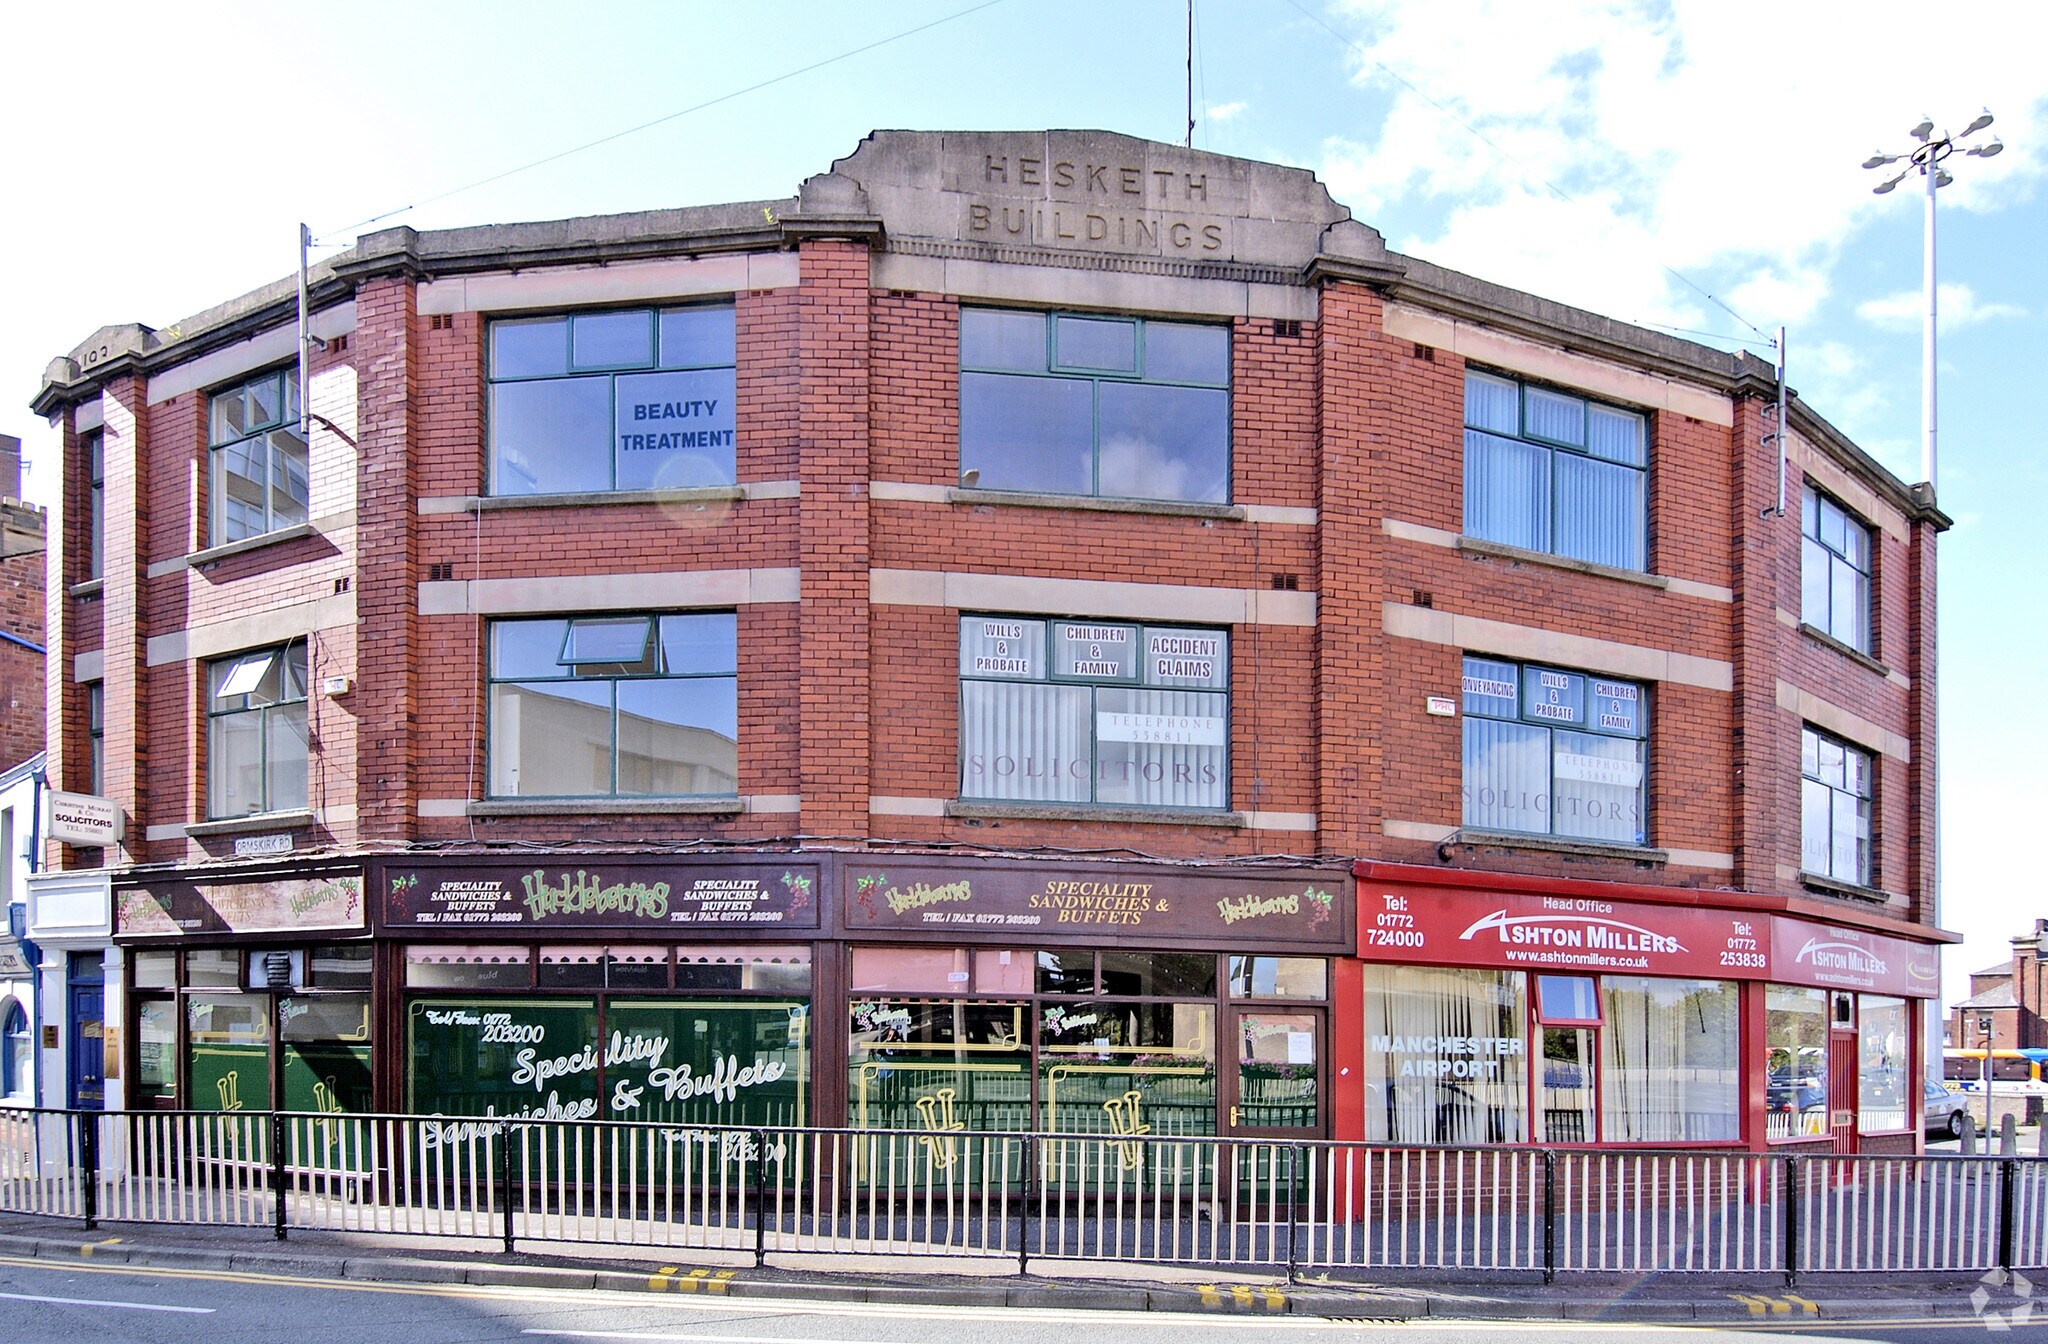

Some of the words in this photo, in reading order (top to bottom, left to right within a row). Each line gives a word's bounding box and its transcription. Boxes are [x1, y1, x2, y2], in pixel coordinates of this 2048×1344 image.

[985, 154, 1207, 201] HESKETH
[969, 203, 1222, 251] BUILDINGS
[634, 400, 718, 420] BEAUTY
[621, 430, 734, 451] TREATMENT
[985, 624, 1021, 638] WILLS
[1067, 627, 1125, 641] CHILDREN
[999, 642, 1006, 654] &
[1091, 645, 1101, 658] &
[1152, 638, 1217, 656] ACCIDENT
[976, 659, 1027, 672] PROBATE
[1075, 662, 1118, 675] FAMILY
[1158, 661, 1211, 677] CLAIMS
[1542, 674, 1567, 688] WILLS
[1596, 684, 1636, 699] CHILDREN
[1536, 704, 1572, 720] PROBATE
[1112, 715, 1214, 730] TELEPHONE
[1601, 715, 1631, 729] FAMILY
[1132, 730, 1193, 743] 558811
[968, 755, 1217, 784] SOLICITORS
[1565, 755, 1637, 772] TELEPHONE
[1462, 785, 1638, 823] SOLICITORS
[55, 814, 112, 828] SOLICITORS
[236, 839, 277, 852] ORMSKIRK
[440, 882, 502, 891] SPECIALITY
[693, 880, 760, 890] SPECIALITY
[1045, 880, 1153, 897] SPECIALITY
[430, 891, 501, 901] SANDWICHES
[502, 891, 512, 901] &
[521, 869, 670, 921] Huckleberries
[683, 890, 758, 900] SANDWICHES
[759, 890, 770, 900] &
[1028, 894, 1151, 912] SANDWICHES
[1155, 898, 1169, 912] &
[1383, 895, 1408, 911] Tel:
[447, 901, 496, 911] BUFFETS
[701, 901, 753, 911] BUFFETS
[1544, 897, 1572, 910] Head
[1577, 900, 1613, 913] Office
[1057, 909, 1142, 925] BUFFETS
[1377, 913, 1414, 928] 01772
[1733, 922, 1752, 936] Tel:
[1367, 929, 1424, 948] 724000
[1587, 926, 1679, 953] MILLERS
[1727, 938, 1756, 950] 01772
[1506, 950, 1649, 968] www.ashtonmillers.co.uk
[1720, 952, 1766, 968] 253838
[1849, 951, 1887, 975] MILLERS
[482, 1024, 545, 1043] 203200
[1371, 1035, 1524, 1055] MANCHESTER
[512, 1030, 669, 1091] Speciality
[1400, 1060, 1498, 1077] AIRPORT
[611, 1079, 644, 1111] &
[648, 1054, 786, 1104] Buffets
